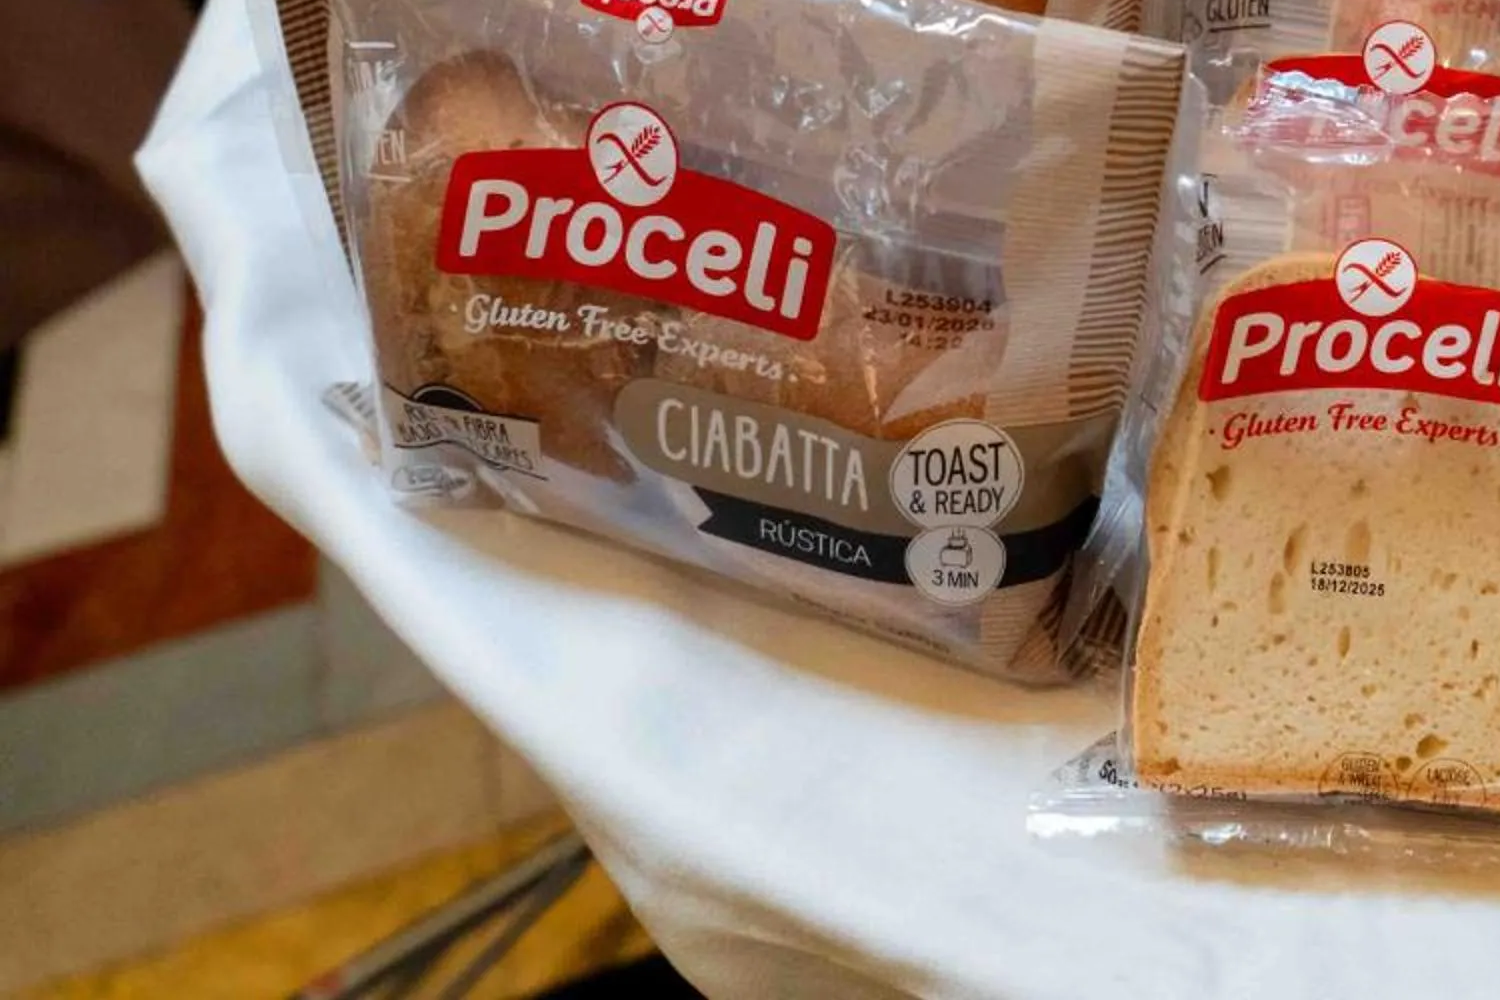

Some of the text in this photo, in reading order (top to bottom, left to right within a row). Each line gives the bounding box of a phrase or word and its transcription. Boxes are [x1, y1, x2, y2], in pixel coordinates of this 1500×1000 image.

[458, 179, 813, 319] Proceli
[464, 294, 784, 382] Gluten Free Experts
[1221, 402, 1499, 451] Gluten Free Experts
[656, 398, 869, 512] CIABATTA
[908, 441, 1006, 487] TOAST
[908, 486, 1005, 515] & READY
[758, 519, 873, 568] RÚSTICA
[931, 569, 980, 589] 3 MIN
